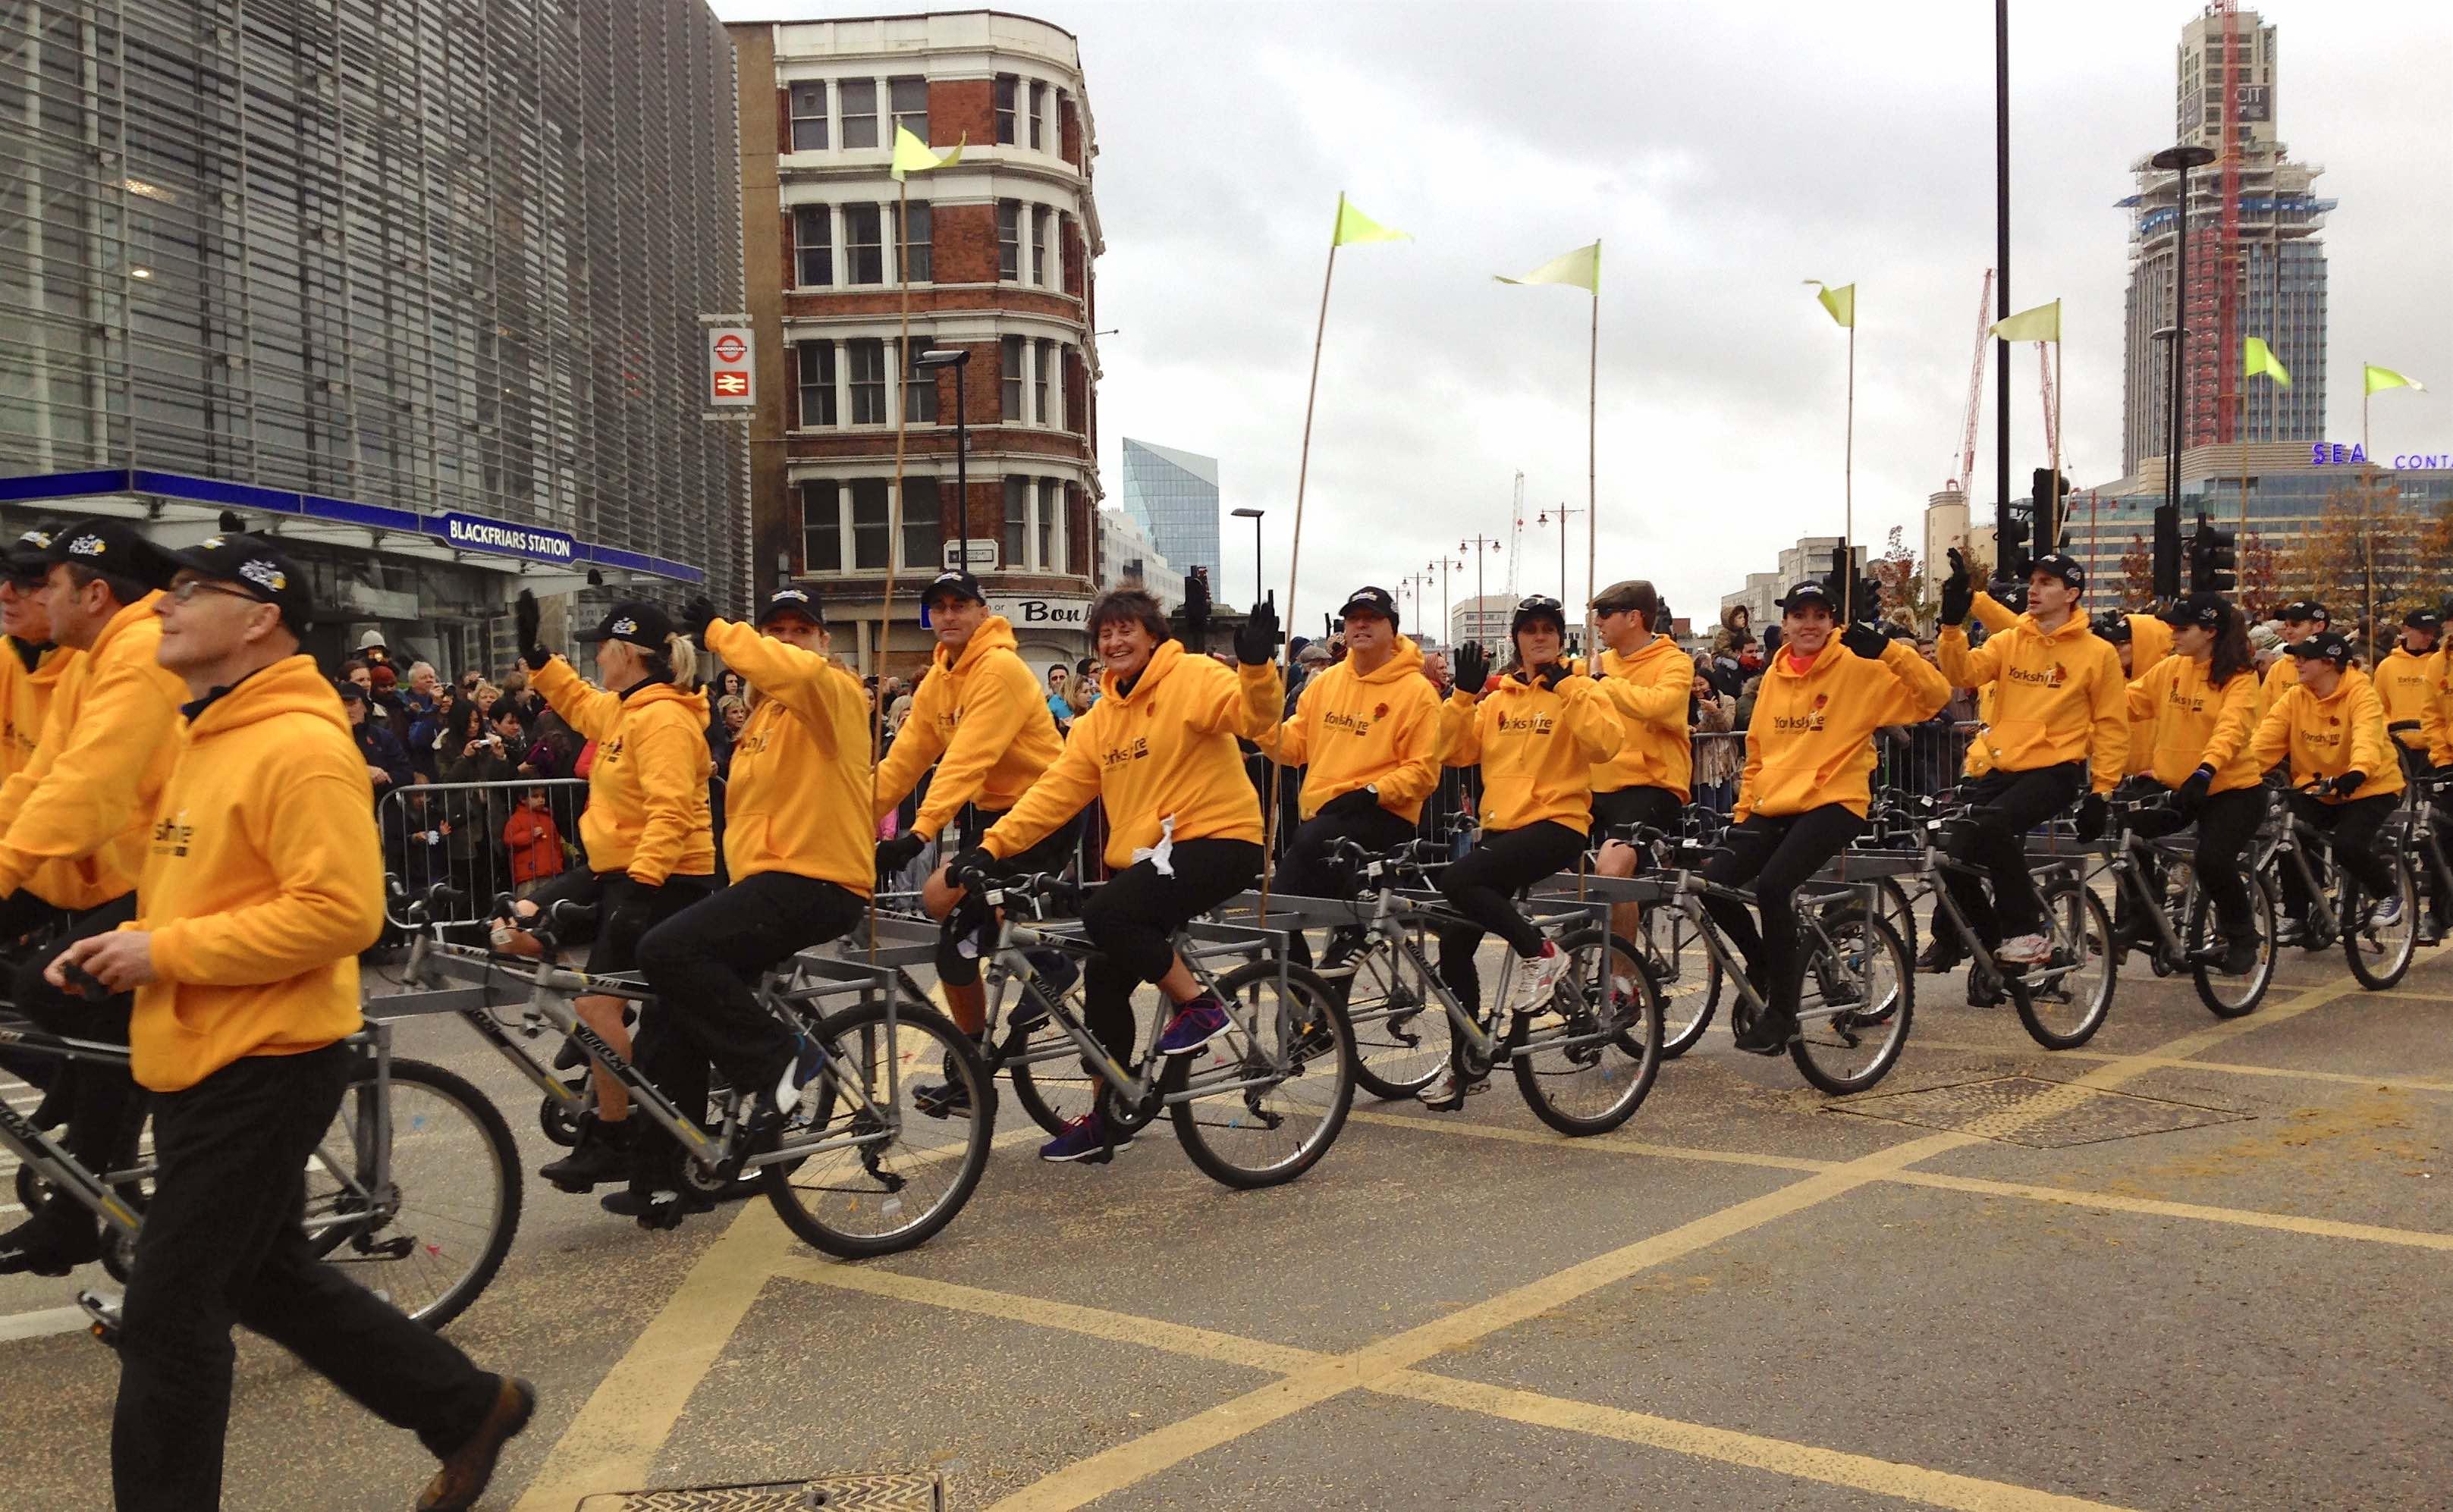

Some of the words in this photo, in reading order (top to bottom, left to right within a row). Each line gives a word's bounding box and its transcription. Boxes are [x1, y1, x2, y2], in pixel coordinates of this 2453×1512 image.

[2235, 87, 2263, 103] CIT
[2312, 442, 2367, 465] SEA
[2395, 454, 2453, 469] CONT
[450, 519, 526, 551] BLACKFRIARS
[528, 534, 570, 557] STATION
[1018, 601, 1082, 623] Bon
